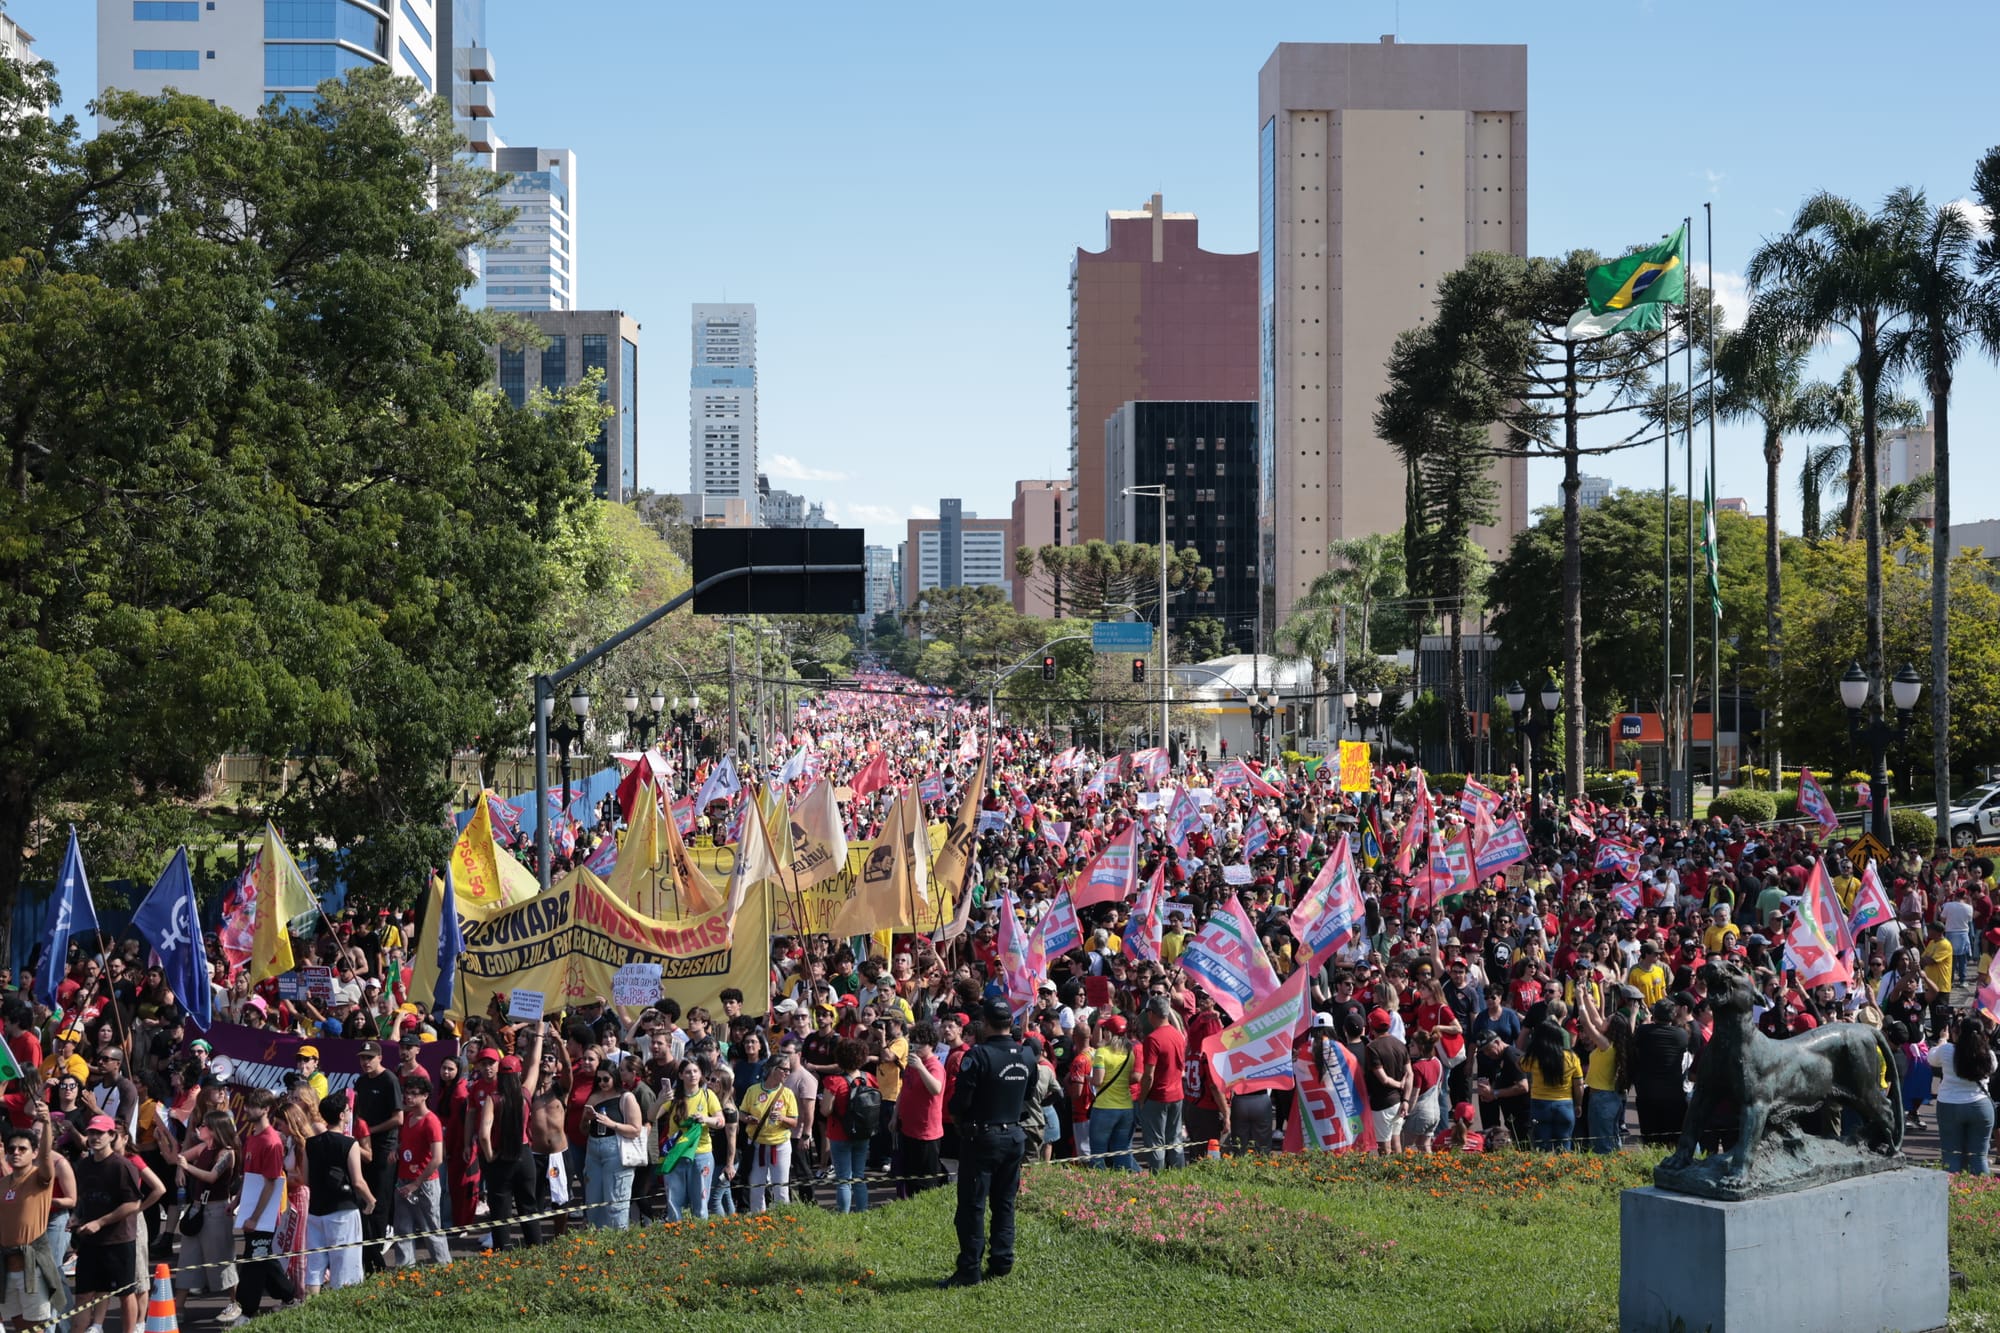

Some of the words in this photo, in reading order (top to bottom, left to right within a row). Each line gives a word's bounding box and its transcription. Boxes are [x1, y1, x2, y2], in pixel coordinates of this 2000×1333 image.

[458, 840, 478, 875] PSOL
[486, 950, 521, 975] COM
[521, 940, 552, 968] LULA
[573, 927, 628, 965] BARRAR
